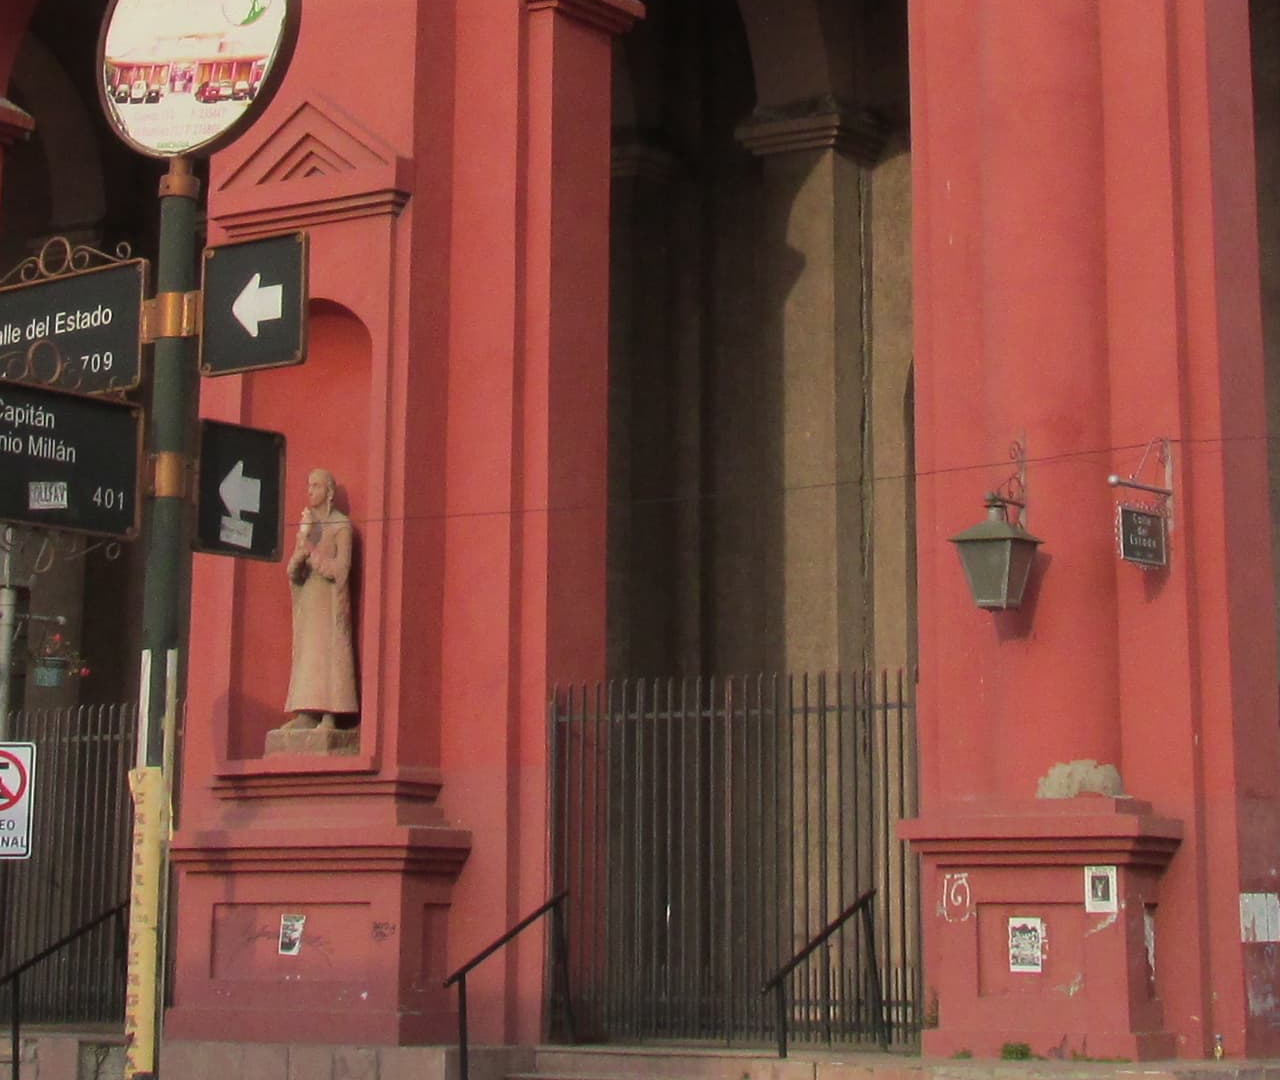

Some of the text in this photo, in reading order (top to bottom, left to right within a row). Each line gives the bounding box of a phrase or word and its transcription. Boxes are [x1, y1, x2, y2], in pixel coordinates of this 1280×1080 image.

[25, 315, 50, 340] del
[55, 304, 113, 335] Estado
[80, 352, 113, 373] 709
[28, 434, 76, 464] Millán
[92, 485, 124, 511] 401
